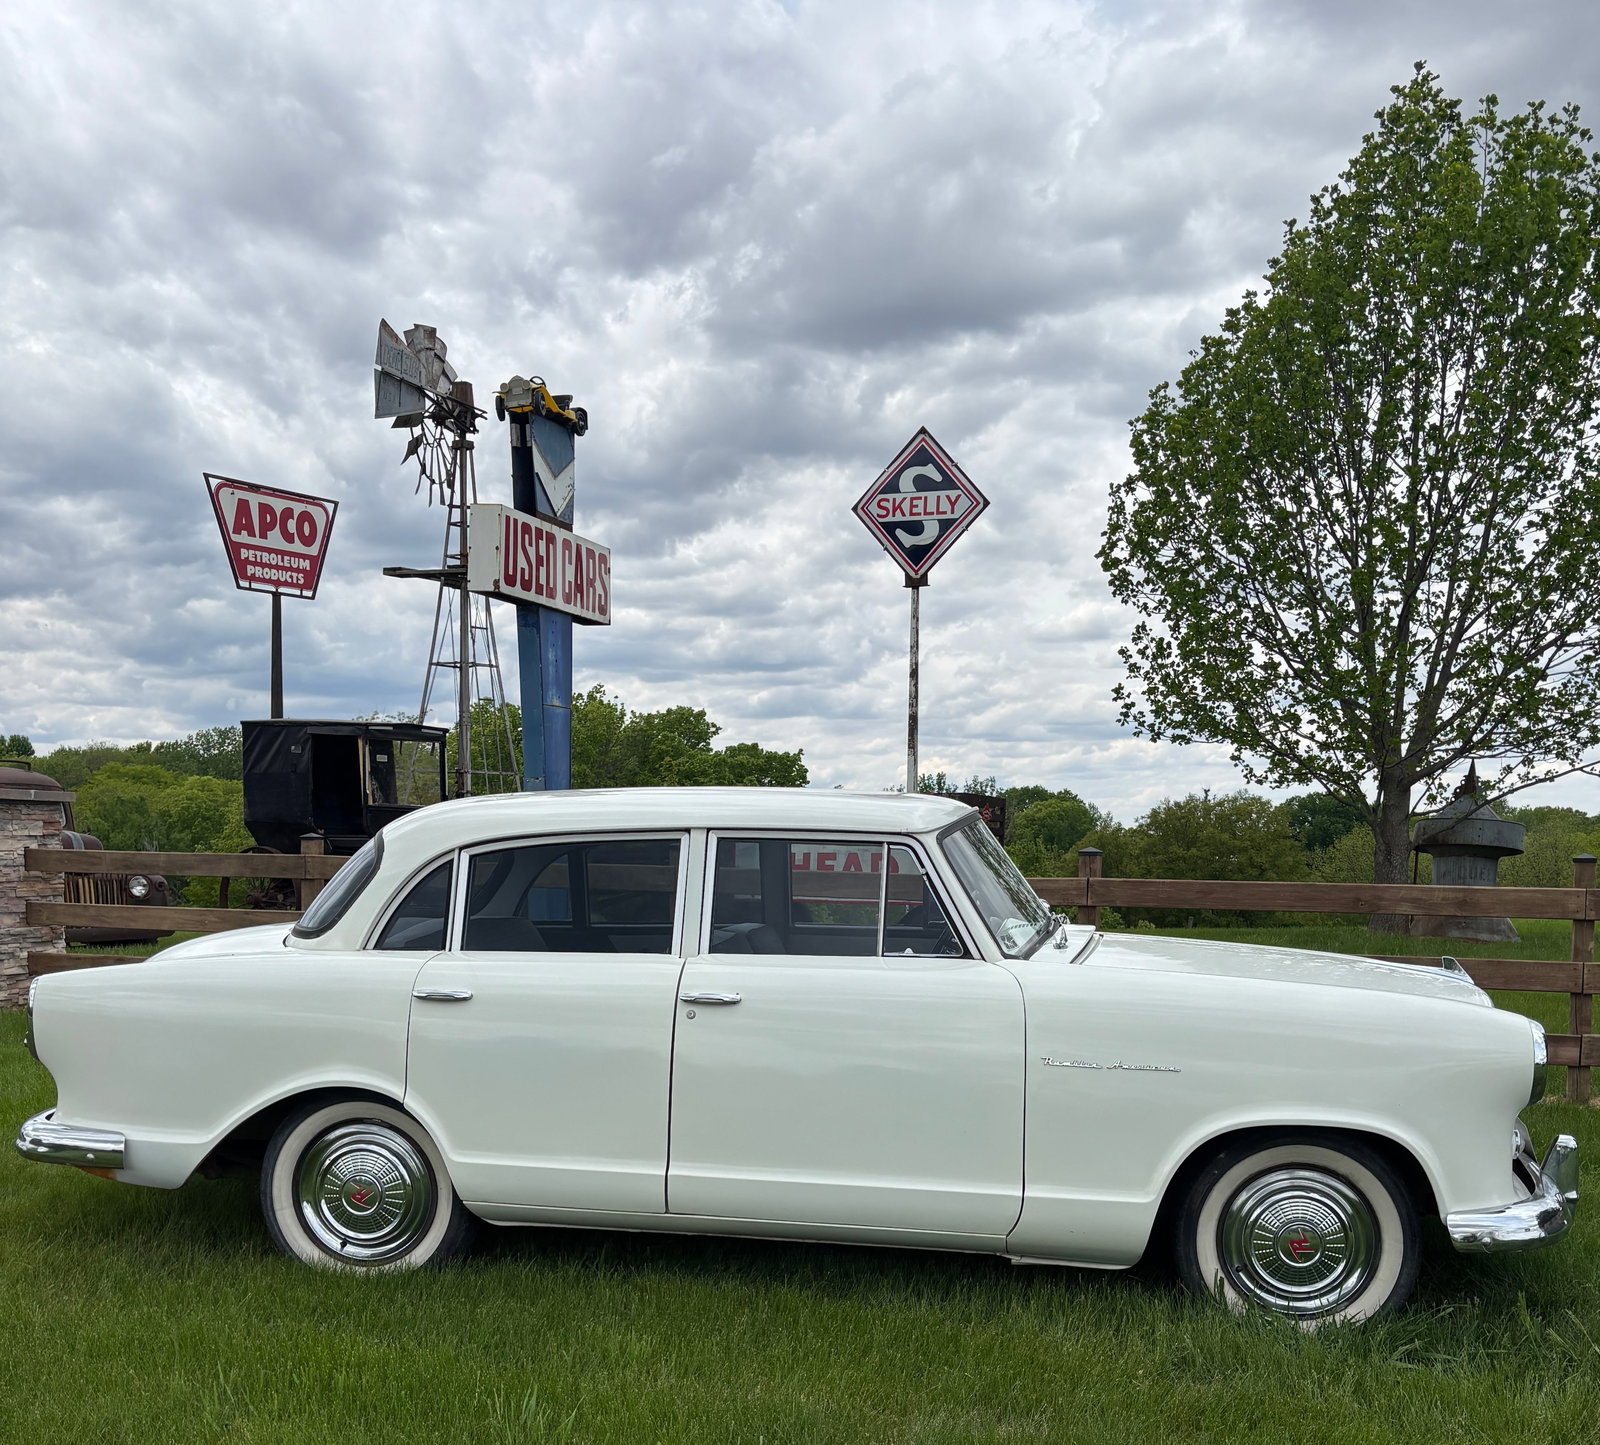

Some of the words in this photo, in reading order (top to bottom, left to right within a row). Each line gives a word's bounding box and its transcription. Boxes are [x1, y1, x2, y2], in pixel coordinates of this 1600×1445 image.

[876, 494, 962, 519] SKELLY
[232, 498, 318, 547] APCO
[240, 548, 310, 570] PETROLEUM
[504, 514, 557, 600] USED
[561, 537, 608, 617] CARS
[246, 565, 305, 584] PRODUCTS
